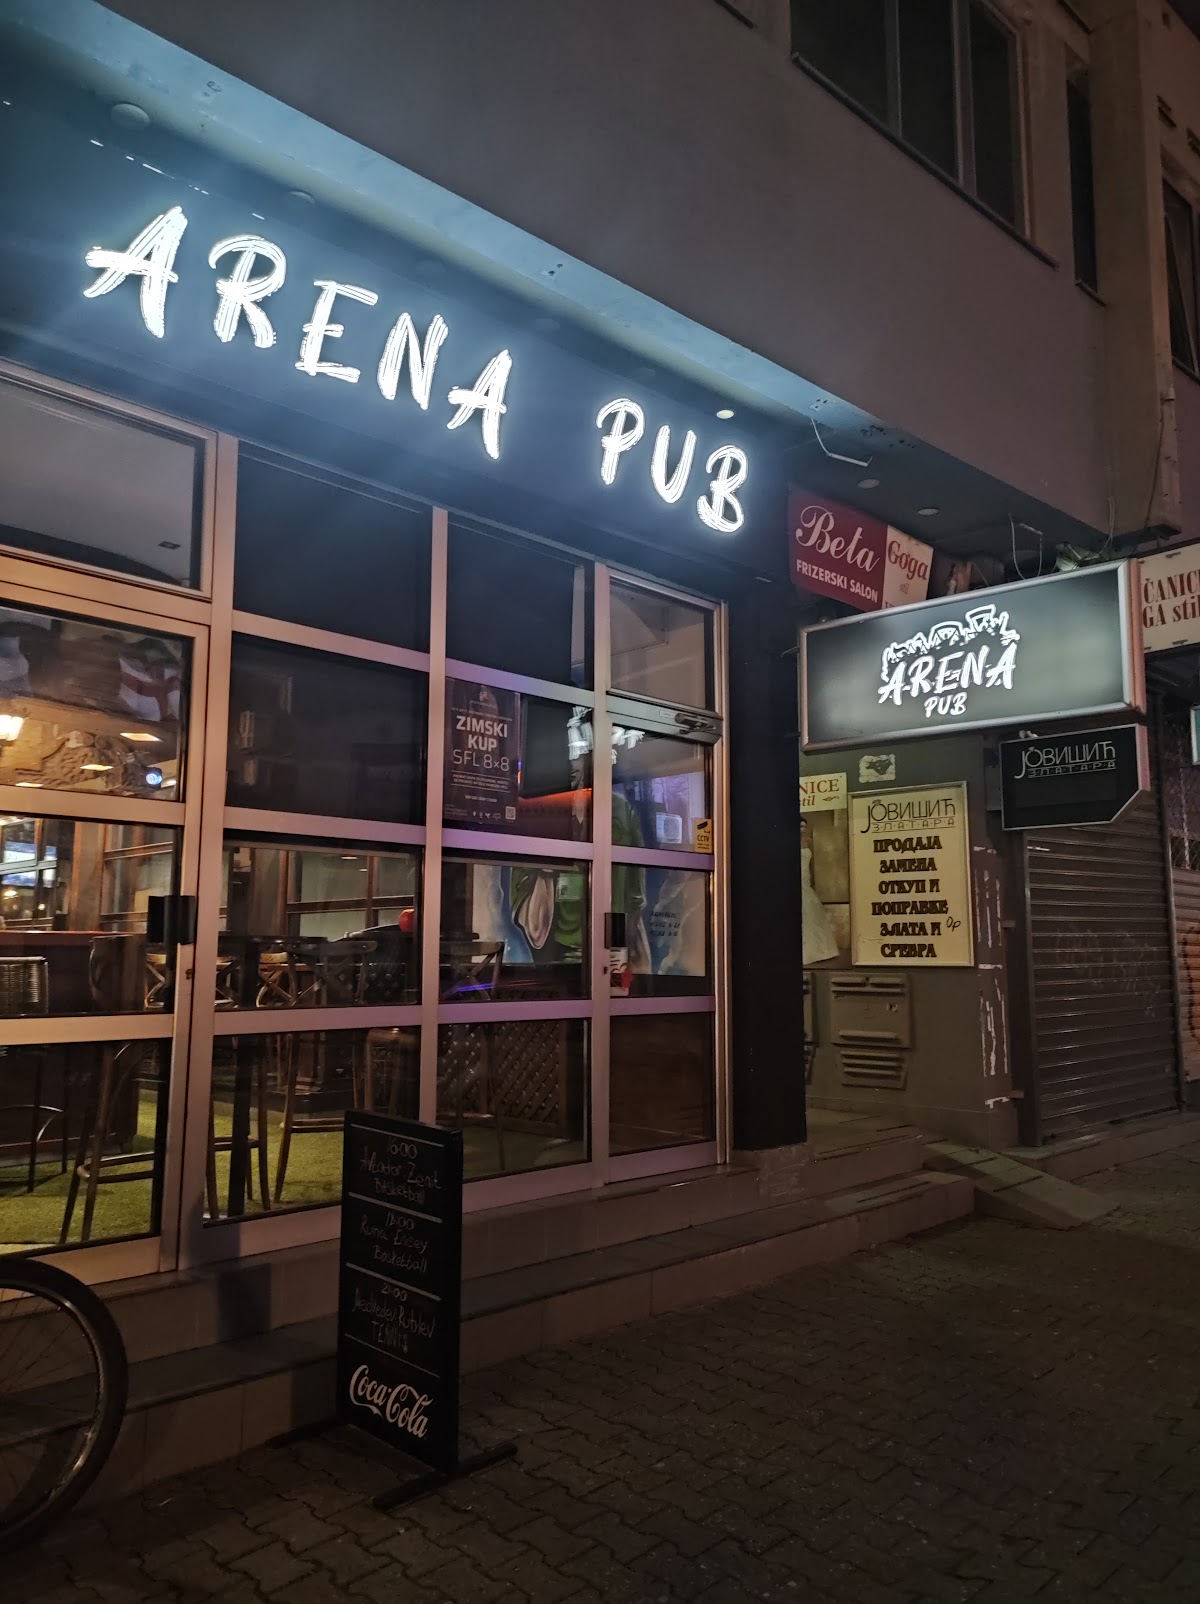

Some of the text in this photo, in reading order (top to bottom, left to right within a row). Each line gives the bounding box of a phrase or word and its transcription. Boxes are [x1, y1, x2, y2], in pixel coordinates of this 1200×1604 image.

[83, 205, 749, 533] ARENA PUB
[795, 505, 880, 572] Beta
[796, 559, 878, 604] FRIZERSKI SALON
[1143, 603, 1167, 629] GA
[878, 643, 1018, 706] ARENA
[924, 691, 968, 718] PUB
[456, 715, 508, 738] ZIMSKI
[468, 734, 498, 752] KUP
[453, 749, 480, 767] SFL
[696, 834, 710, 844] CCTV
[873, 836, 943, 854] ПРОДАЈА
[878, 879, 940, 894] ОТКУП И
[871, 900, 949, 916] ПОПРАВКЕ
[880, 922, 941, 937] ЗЛАТА И
[349, 1364, 434, 1439] Coca-Cola
